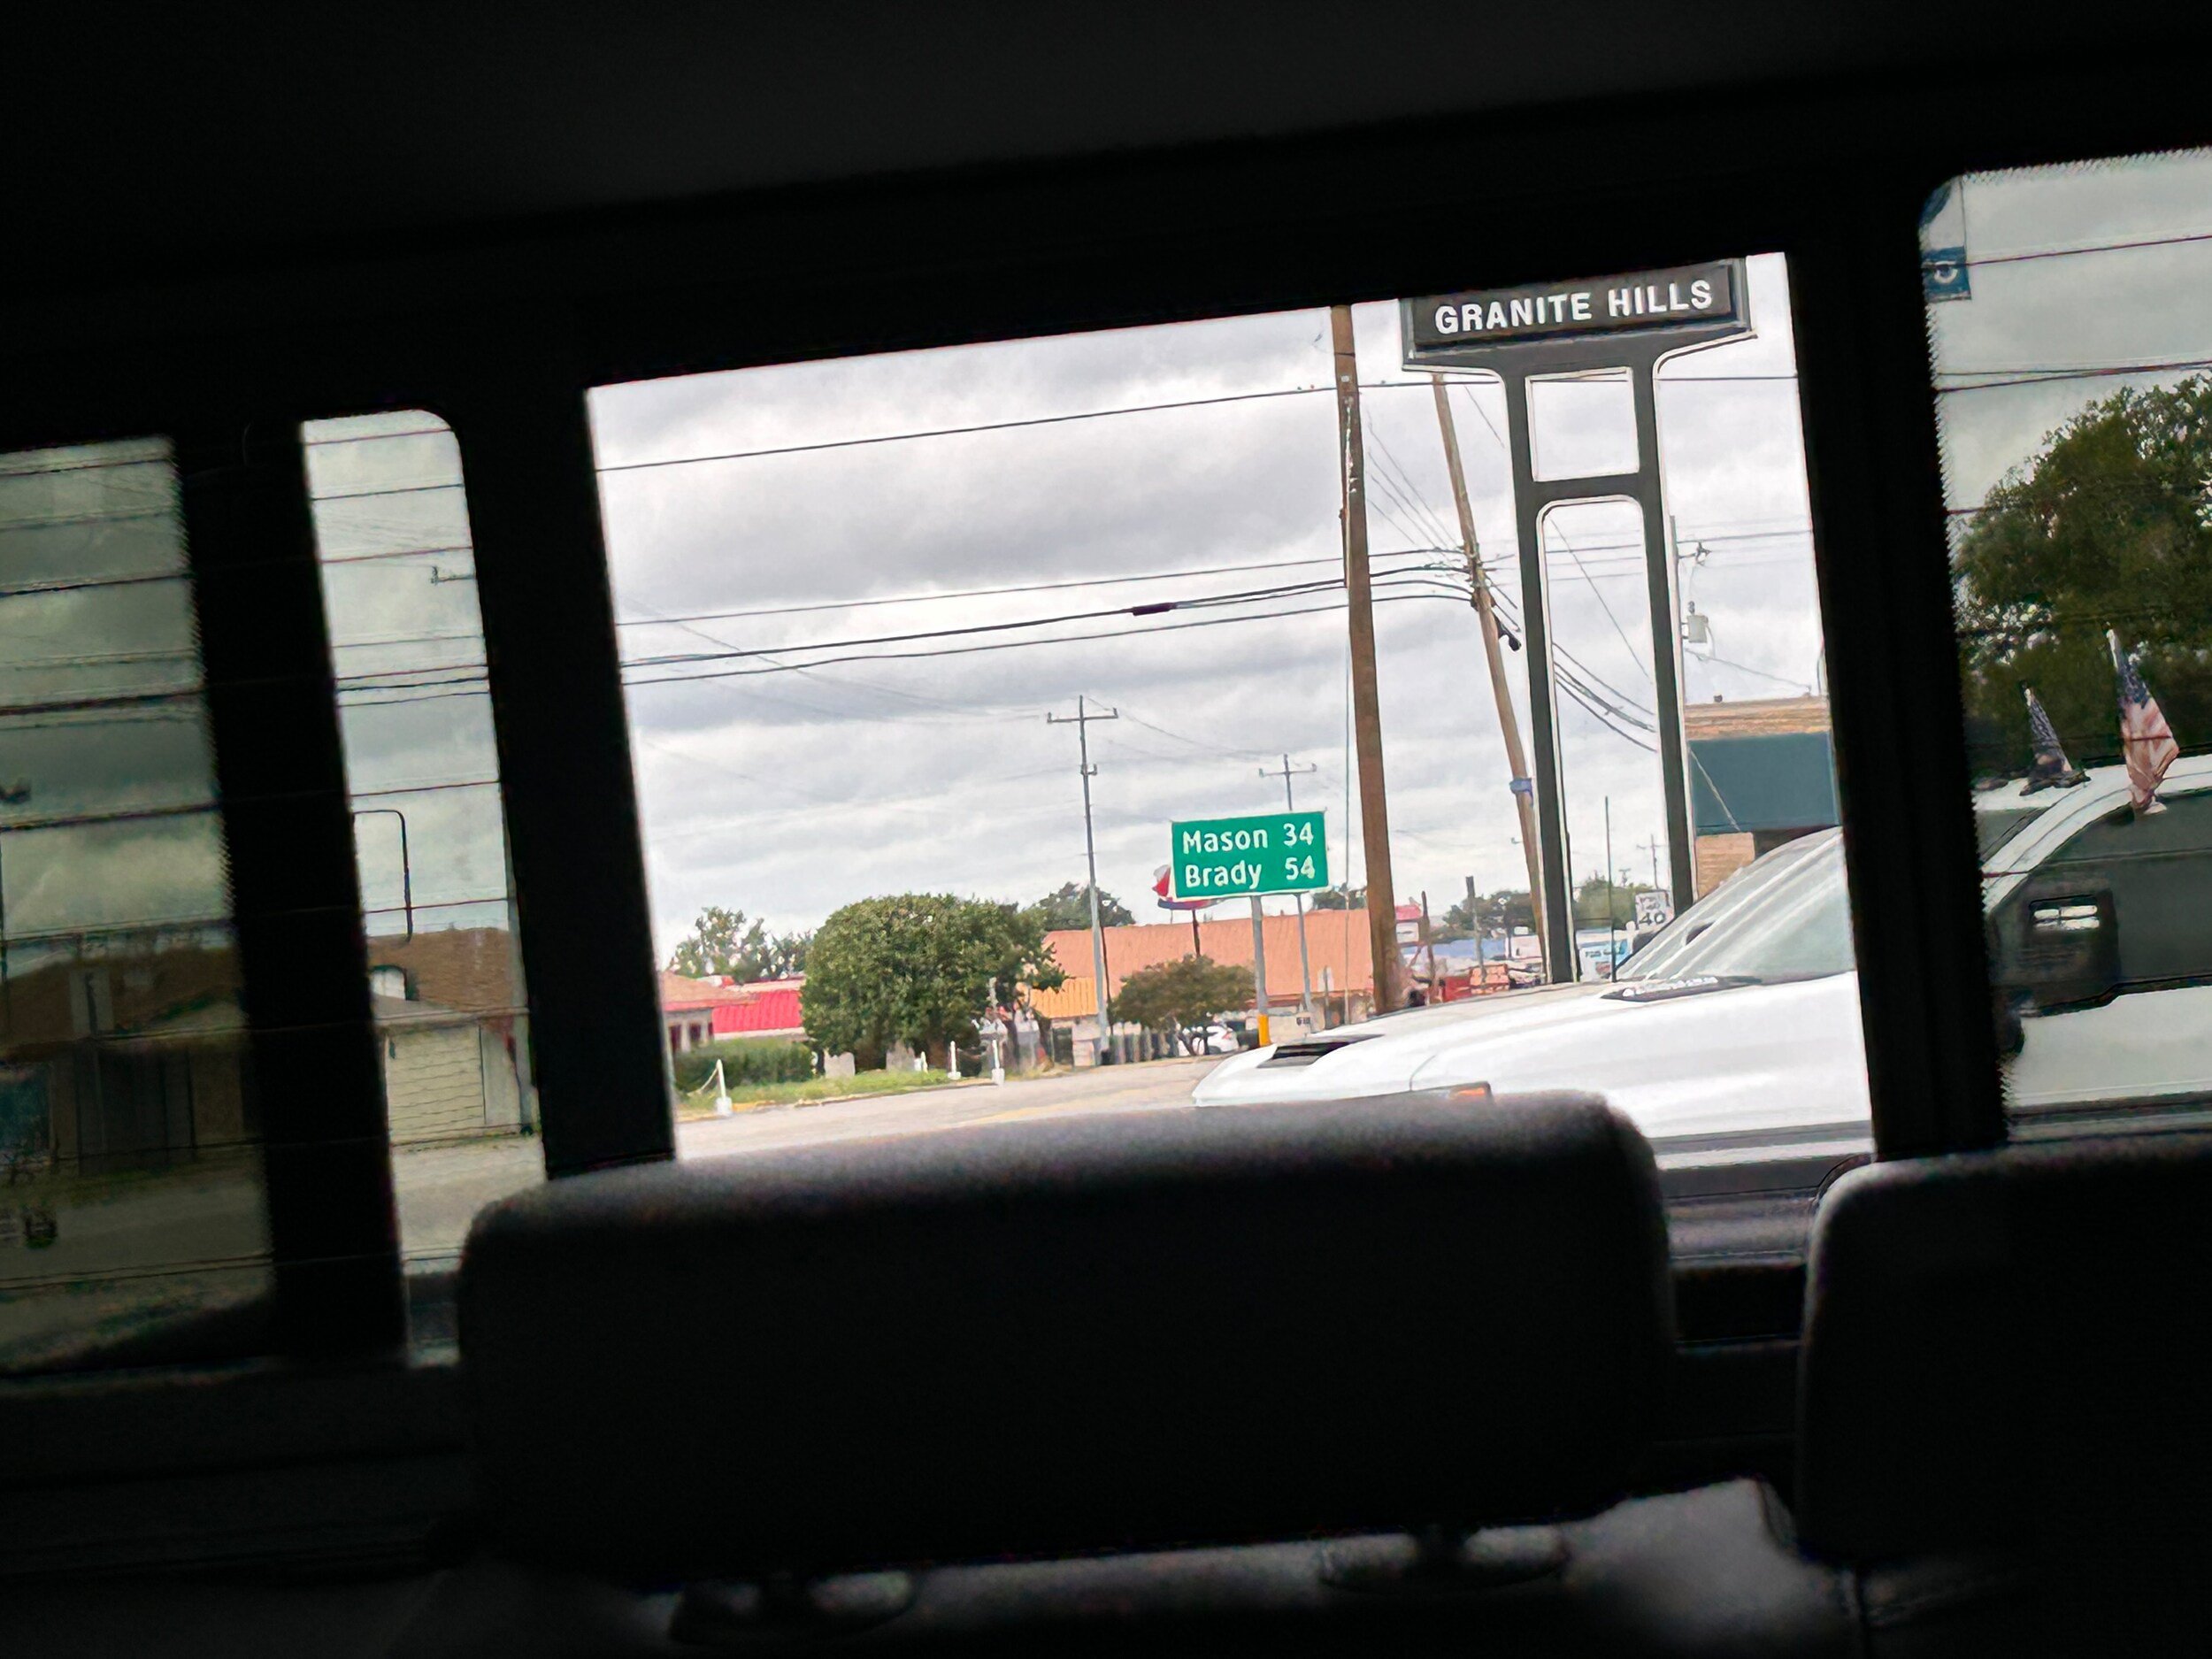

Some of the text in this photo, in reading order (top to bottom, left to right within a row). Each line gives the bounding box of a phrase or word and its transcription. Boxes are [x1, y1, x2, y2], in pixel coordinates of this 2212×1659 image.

[1434, 280, 1713, 334] GRANITE HILLS
[1182, 822, 1314, 854] Mason 34
[1185, 855, 1316, 889] Brady 54
[1639, 910, 1666, 926] 40
